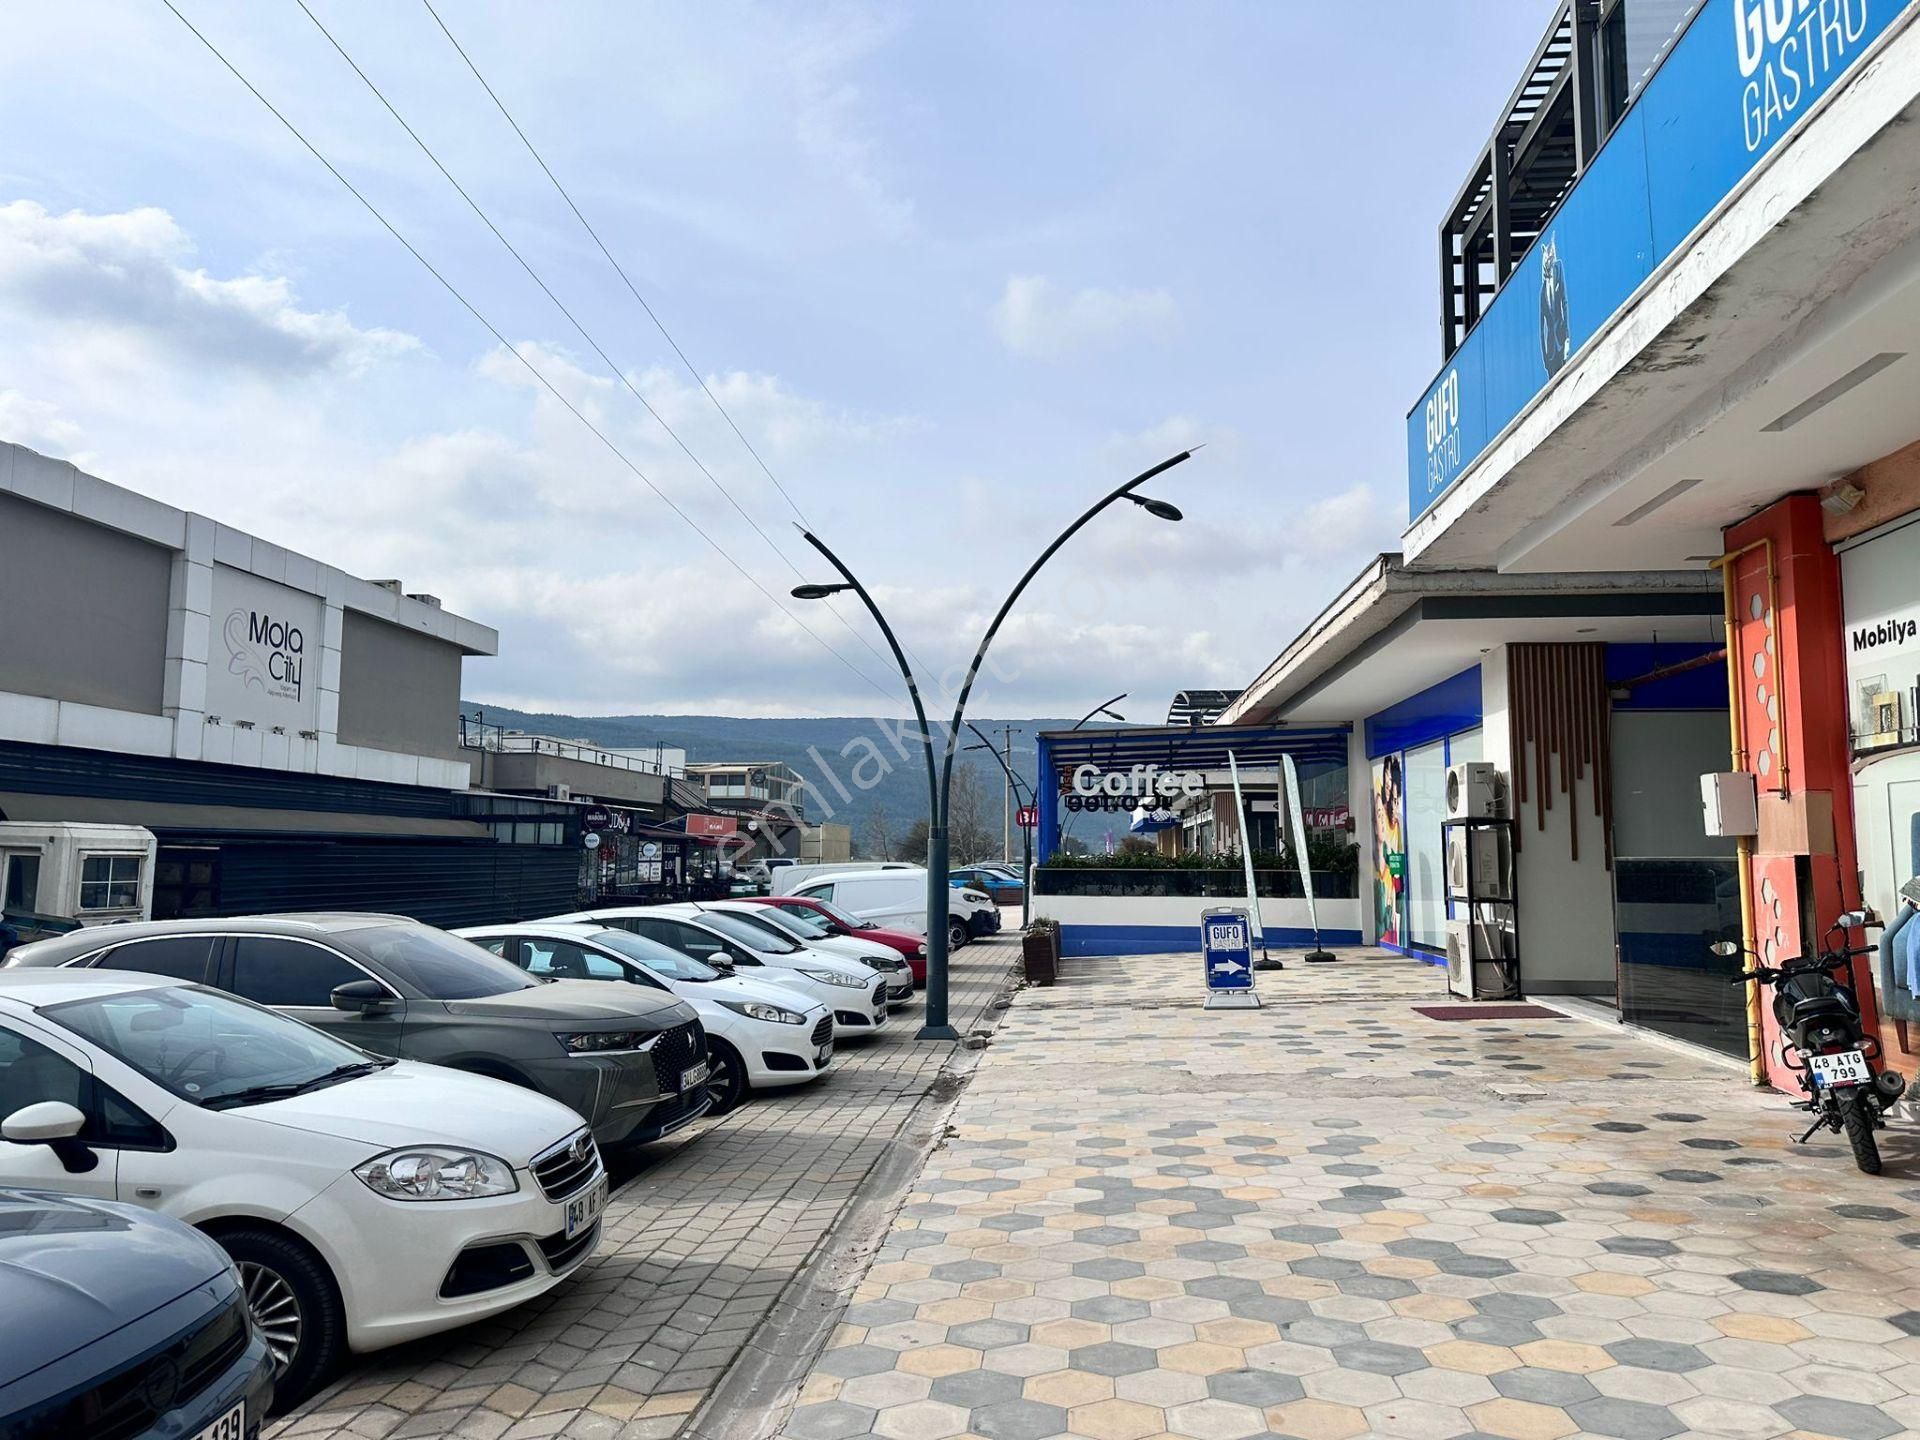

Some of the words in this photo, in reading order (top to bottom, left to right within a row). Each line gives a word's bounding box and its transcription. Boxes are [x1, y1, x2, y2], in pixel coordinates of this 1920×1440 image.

[1426, 369, 1459, 453] GUFO
[1428, 427, 1460, 493] GASTRO
[249, 611, 303, 655] Mola
[1853, 619, 1917, 651] Mobilya
[268, 651, 303, 702] City
[1073, 764, 1205, 797] Coffee
[1213, 926, 1239, 939] GUFO
[1814, 1058, 1829, 1069] 48
[1836, 1053, 1861, 1066] ATG
[1831, 1067, 1856, 1079] 799
